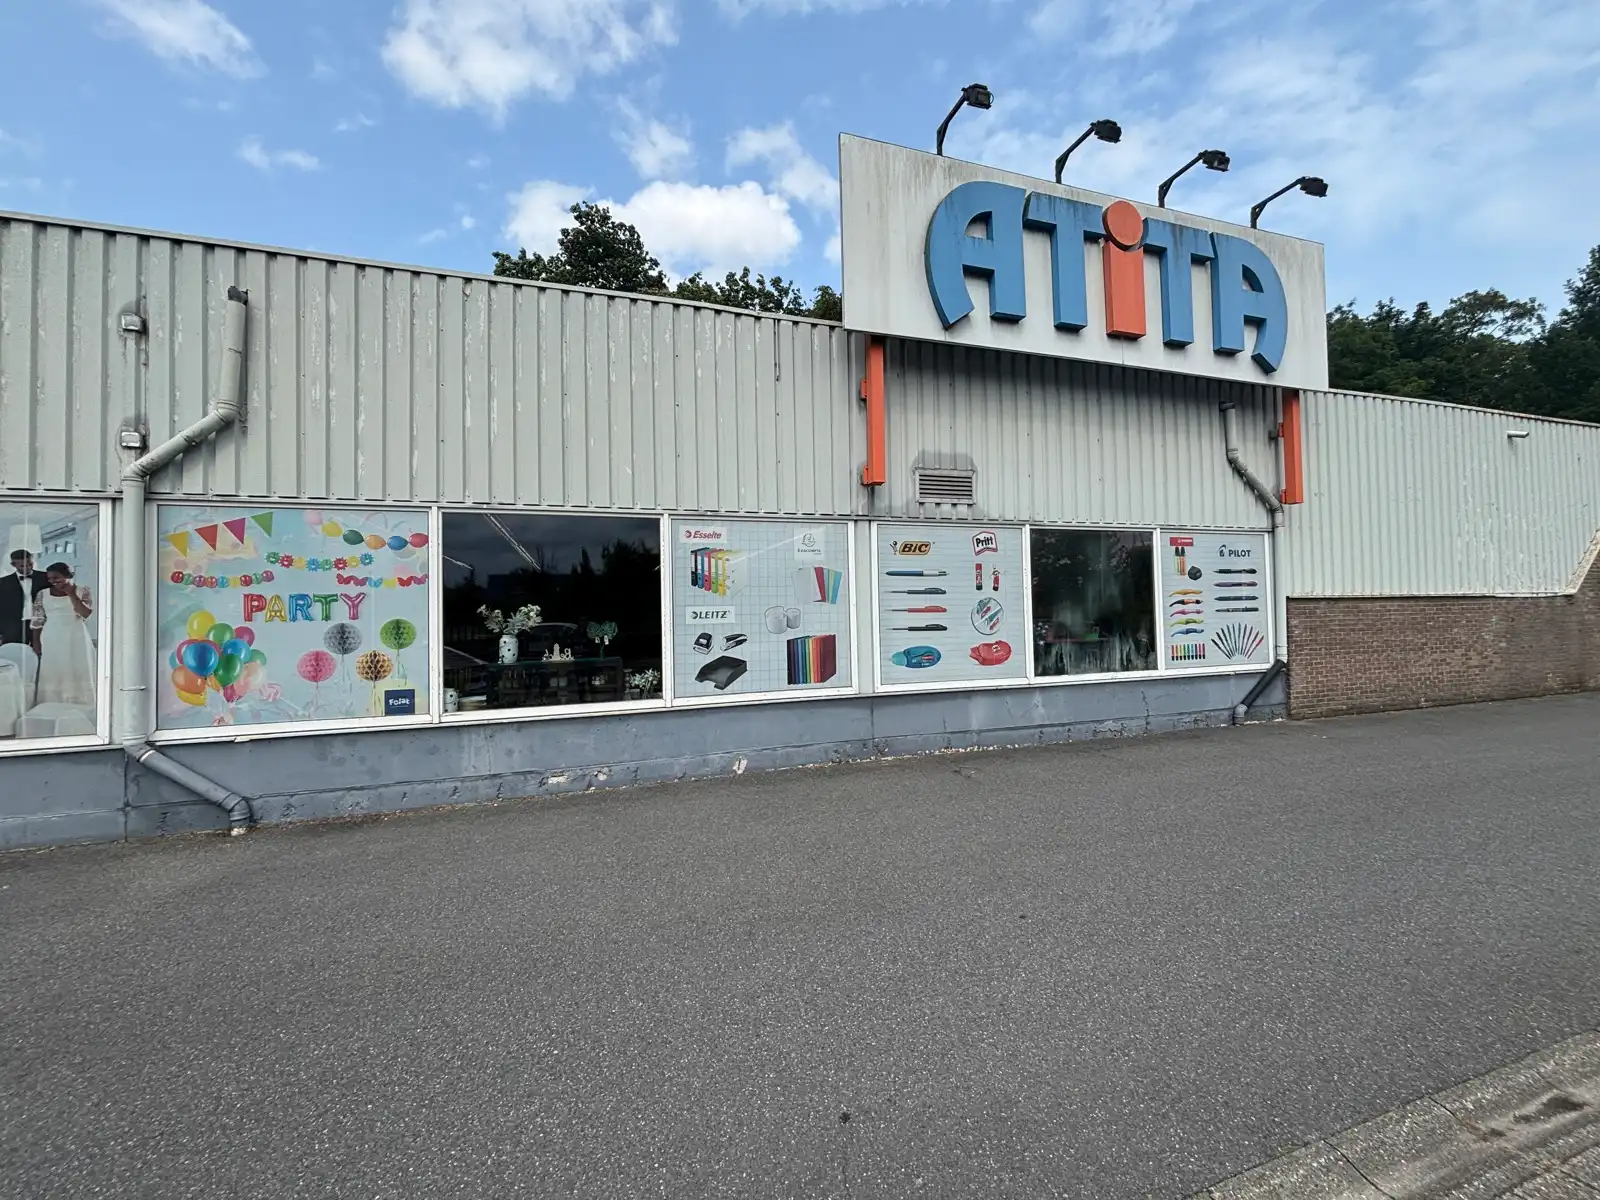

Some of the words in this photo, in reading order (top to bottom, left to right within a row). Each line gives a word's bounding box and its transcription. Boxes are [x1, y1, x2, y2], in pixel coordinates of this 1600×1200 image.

[693, 530, 722, 539] Esselte
[975, 536, 994, 548] Pritt
[1228, 549, 1251, 558] PILOT
[242, 592, 367, 622] PARTY
[699, 610, 728, 619] LEITZ
